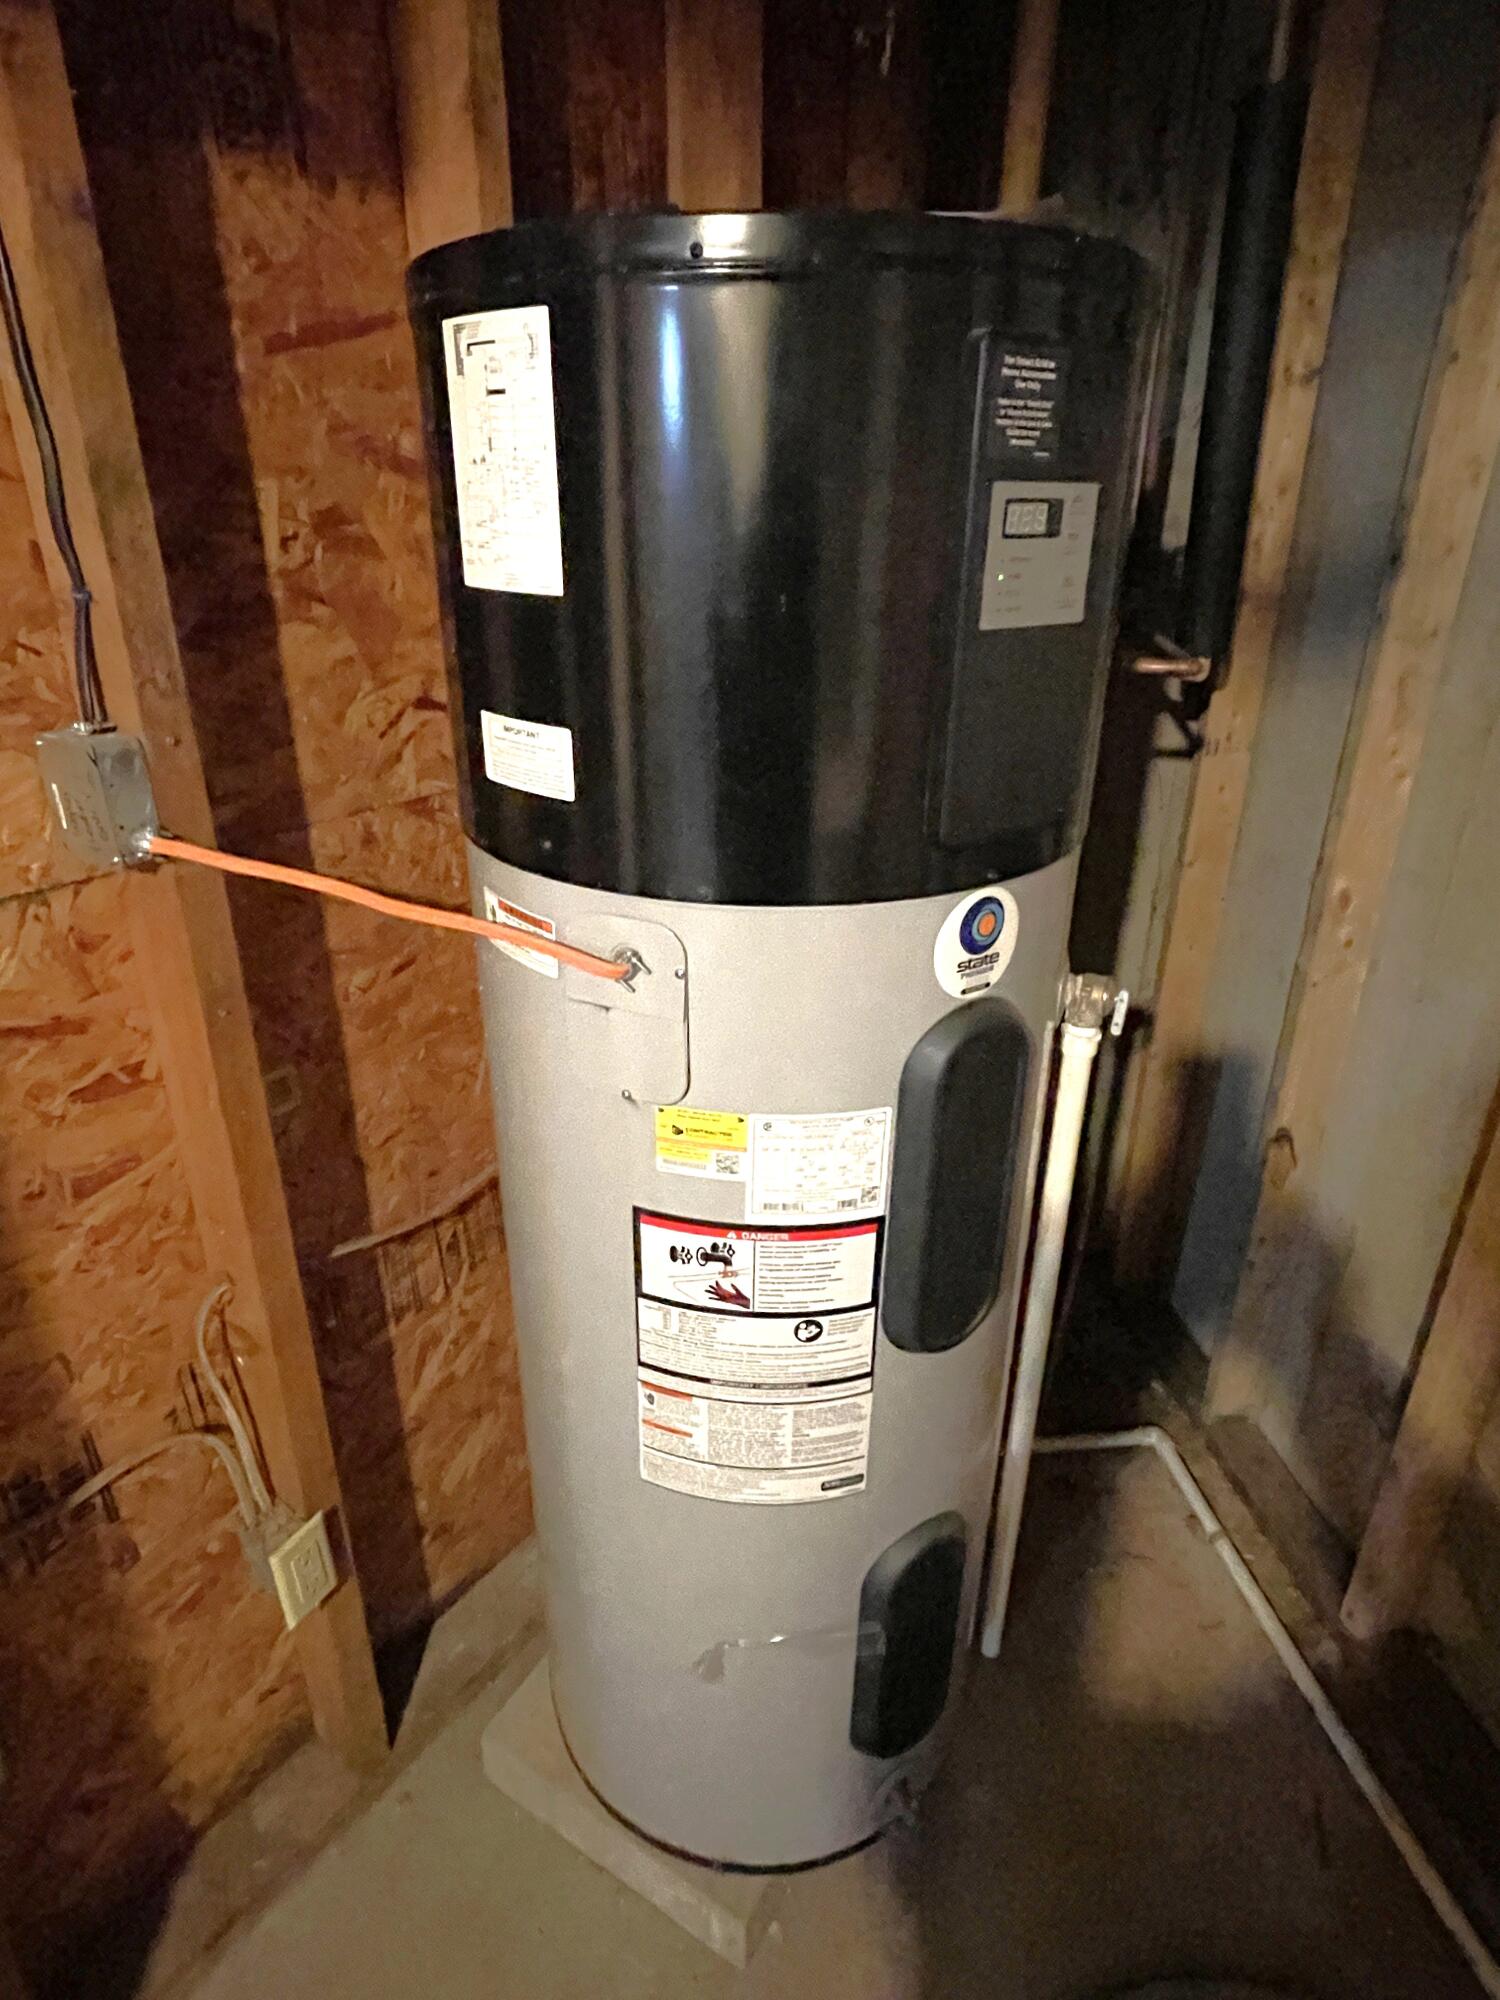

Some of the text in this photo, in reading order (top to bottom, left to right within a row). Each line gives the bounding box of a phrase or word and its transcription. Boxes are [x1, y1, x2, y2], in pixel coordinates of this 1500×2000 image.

[503, 724, 540, 739] IMPORTANT
[956, 951, 1000, 973] state
[741, 1231, 789, 1242] DANGER
